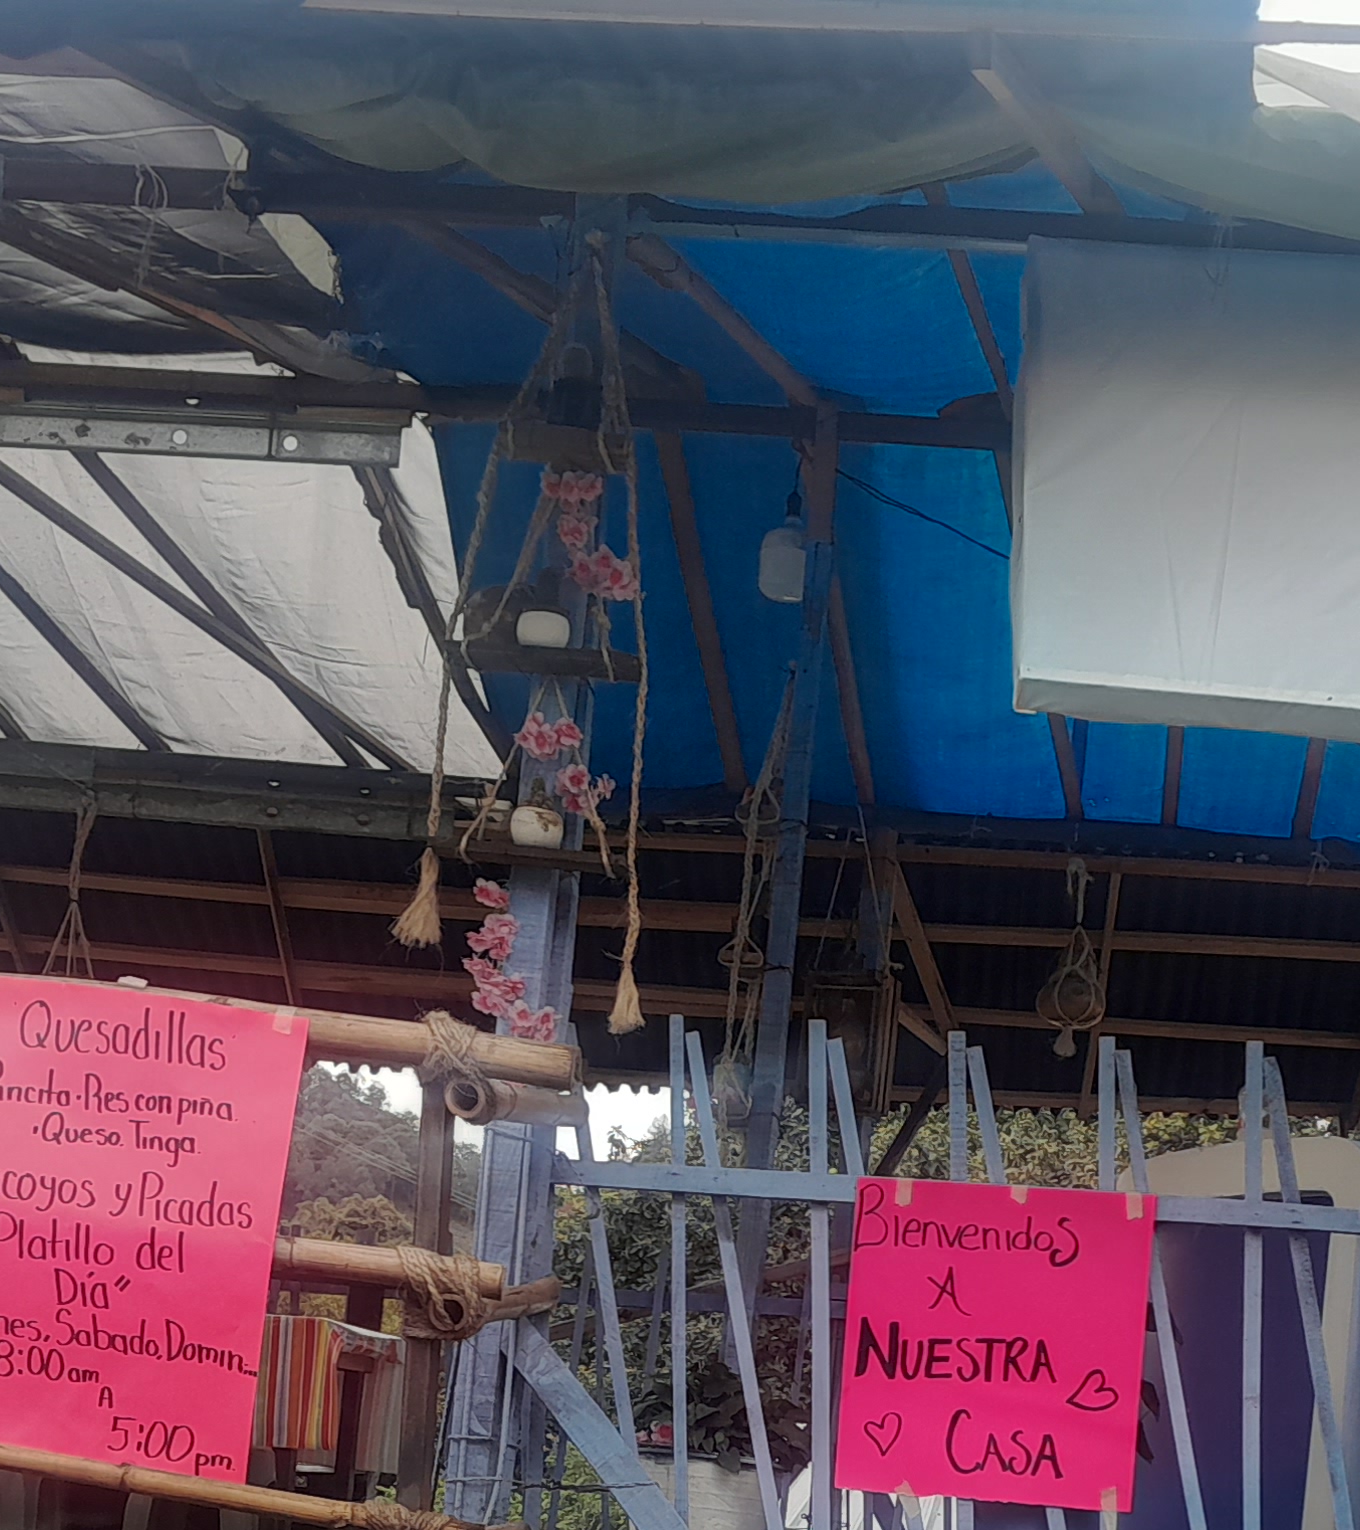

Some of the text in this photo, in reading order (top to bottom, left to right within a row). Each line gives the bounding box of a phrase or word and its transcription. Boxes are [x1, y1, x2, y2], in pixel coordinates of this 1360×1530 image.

[20, 1000, 226, 1071] Quesadillas
[84, 1072, 130, 1114] Res
[134, 1093, 172, 1115] con
[108, 1182, 132, 1217] y
[139, 1171, 254, 1229] Picadas
[135, 1226, 185, 1273] del
[927, 1266, 972, 1316] A
[98, 1386, 114, 1409] A
